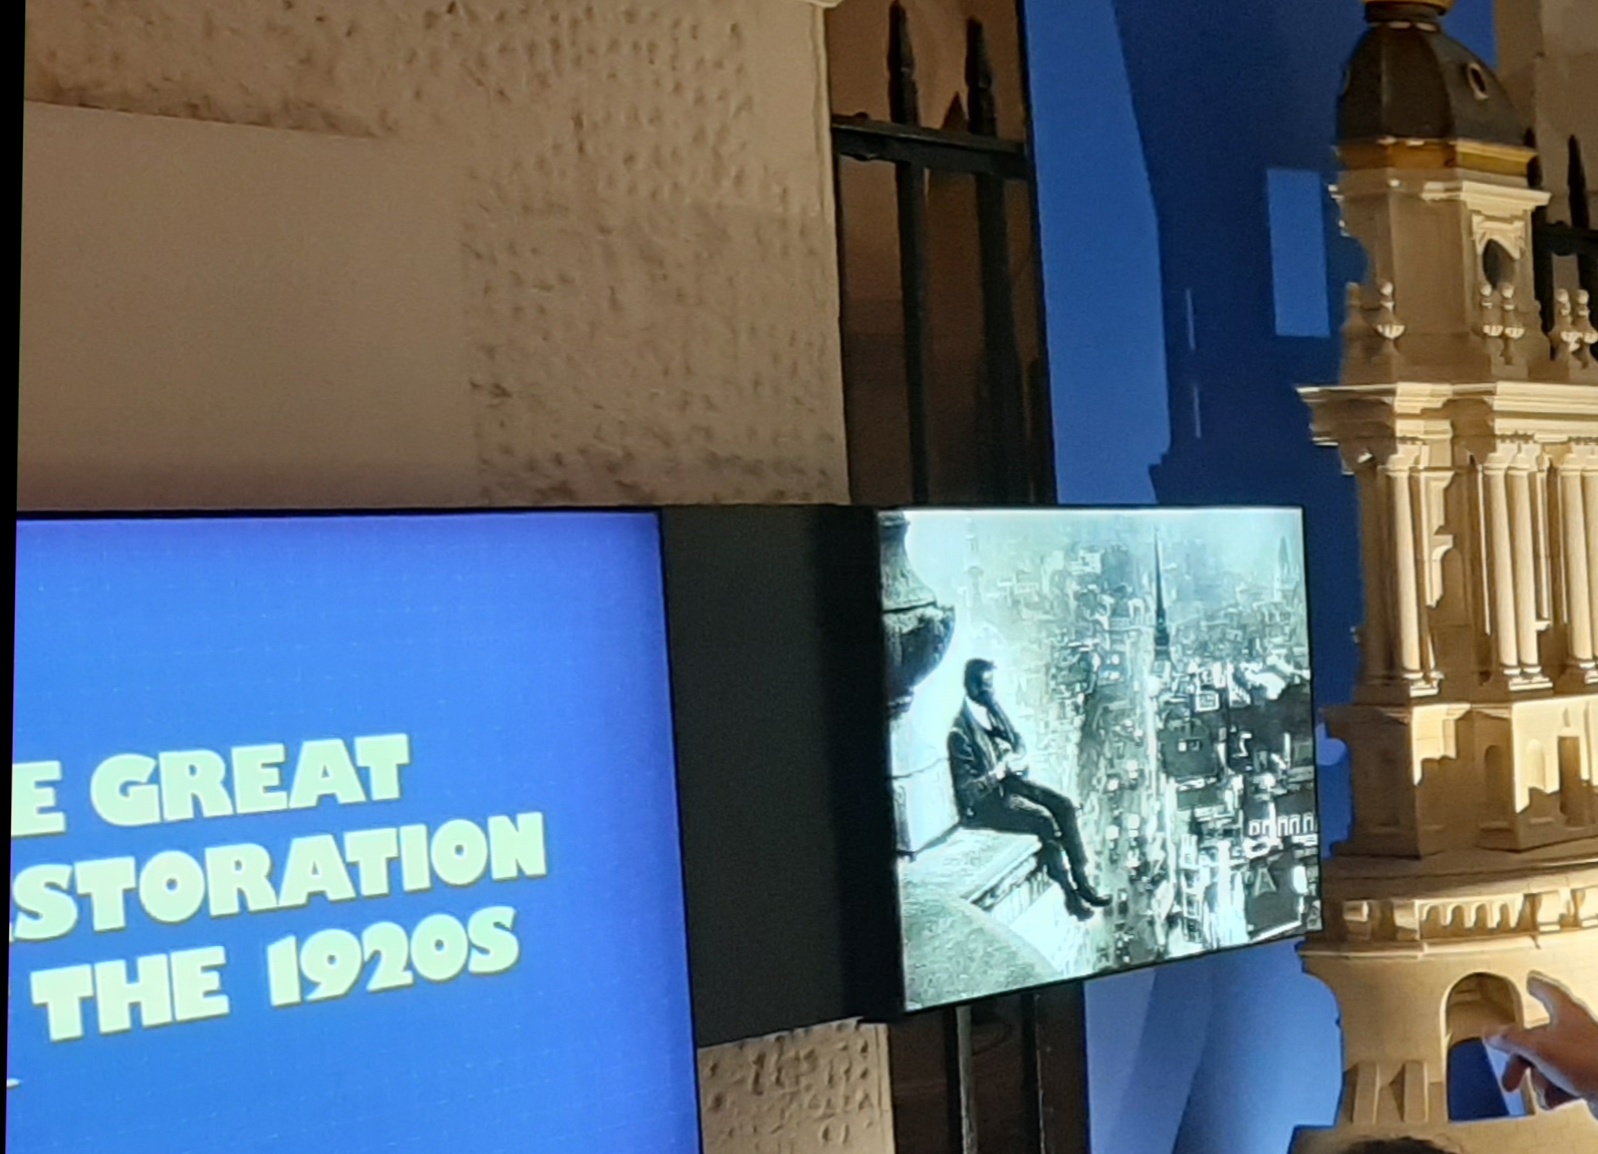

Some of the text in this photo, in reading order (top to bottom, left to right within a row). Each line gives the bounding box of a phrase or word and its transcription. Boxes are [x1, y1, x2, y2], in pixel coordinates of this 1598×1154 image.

[90, 733, 410, 827] GREAT
[9, 811, 547, 942] STORATION
[31, 906, 519, 1041] THE 1920S
